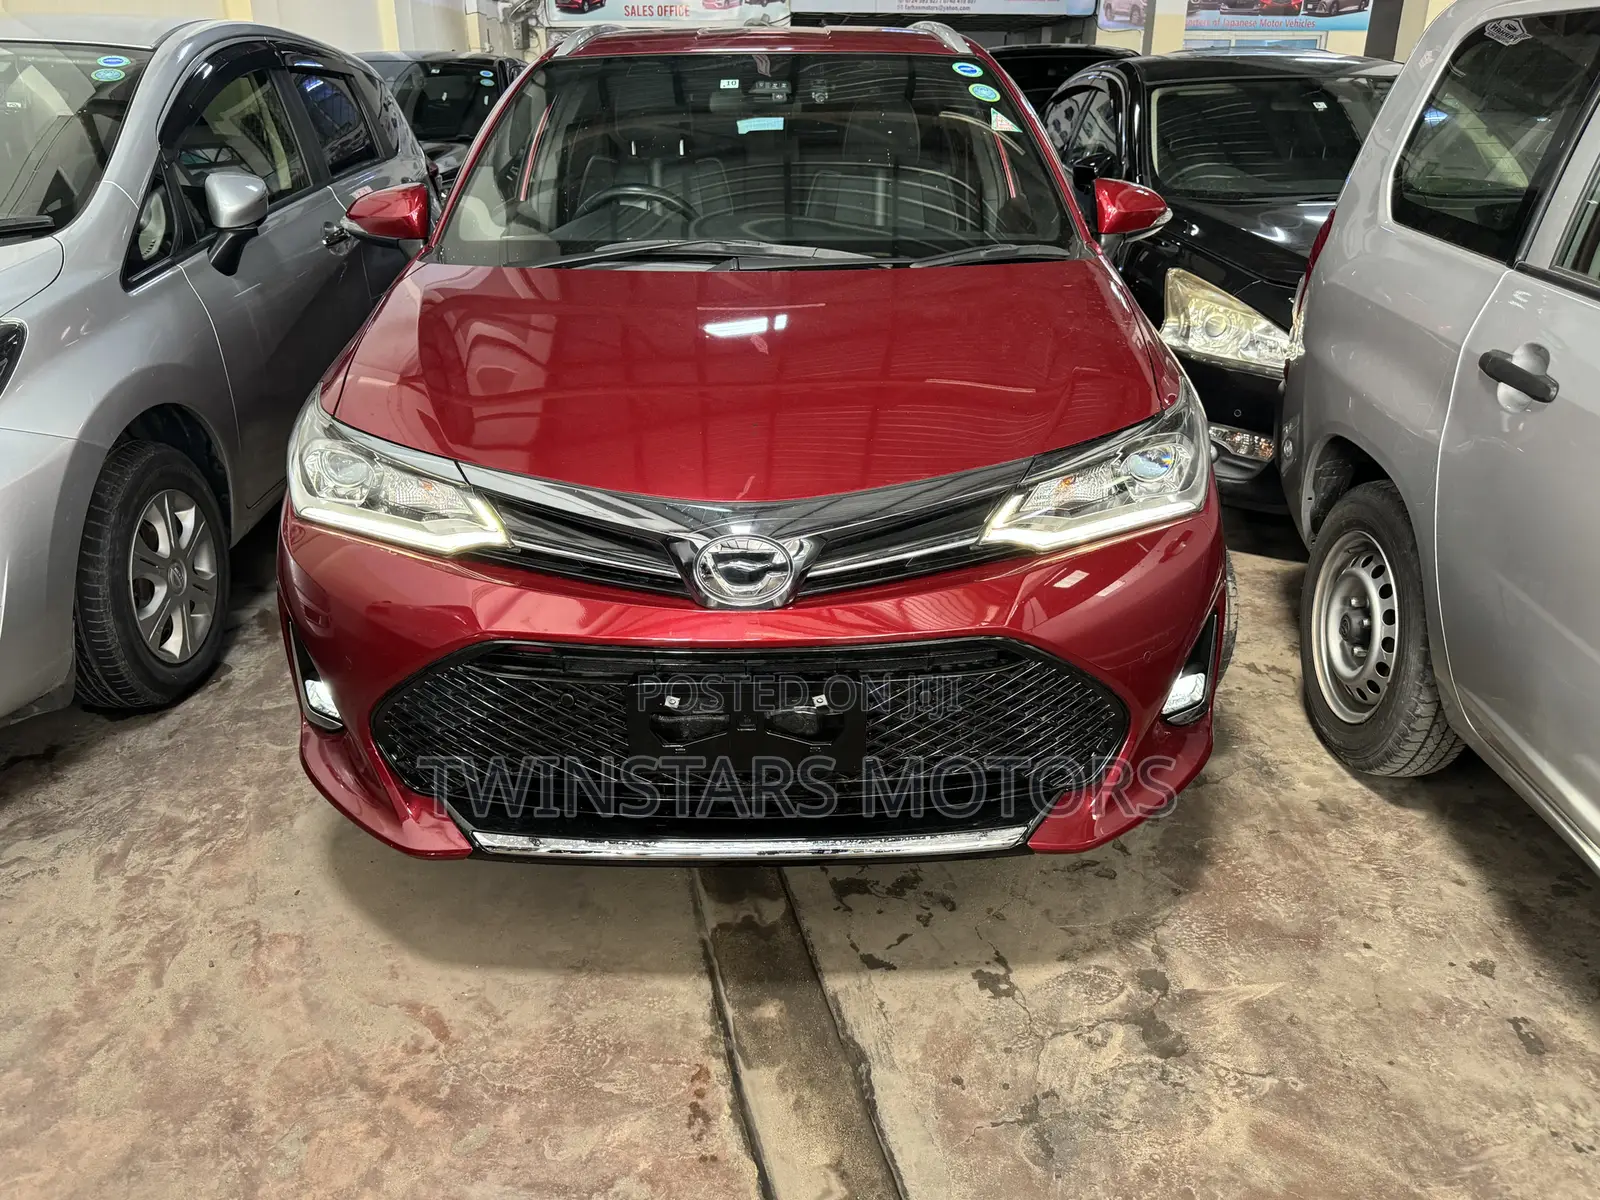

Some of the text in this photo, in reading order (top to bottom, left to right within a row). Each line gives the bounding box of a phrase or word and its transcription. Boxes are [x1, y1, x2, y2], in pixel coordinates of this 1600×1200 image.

[624, 5, 690, 17] SALES OFFICE
[1223, 18, 1257, 29] Japanese
[1260, 18, 1283, 27] Motor
[1285, 18, 1316, 28] Vehicles
